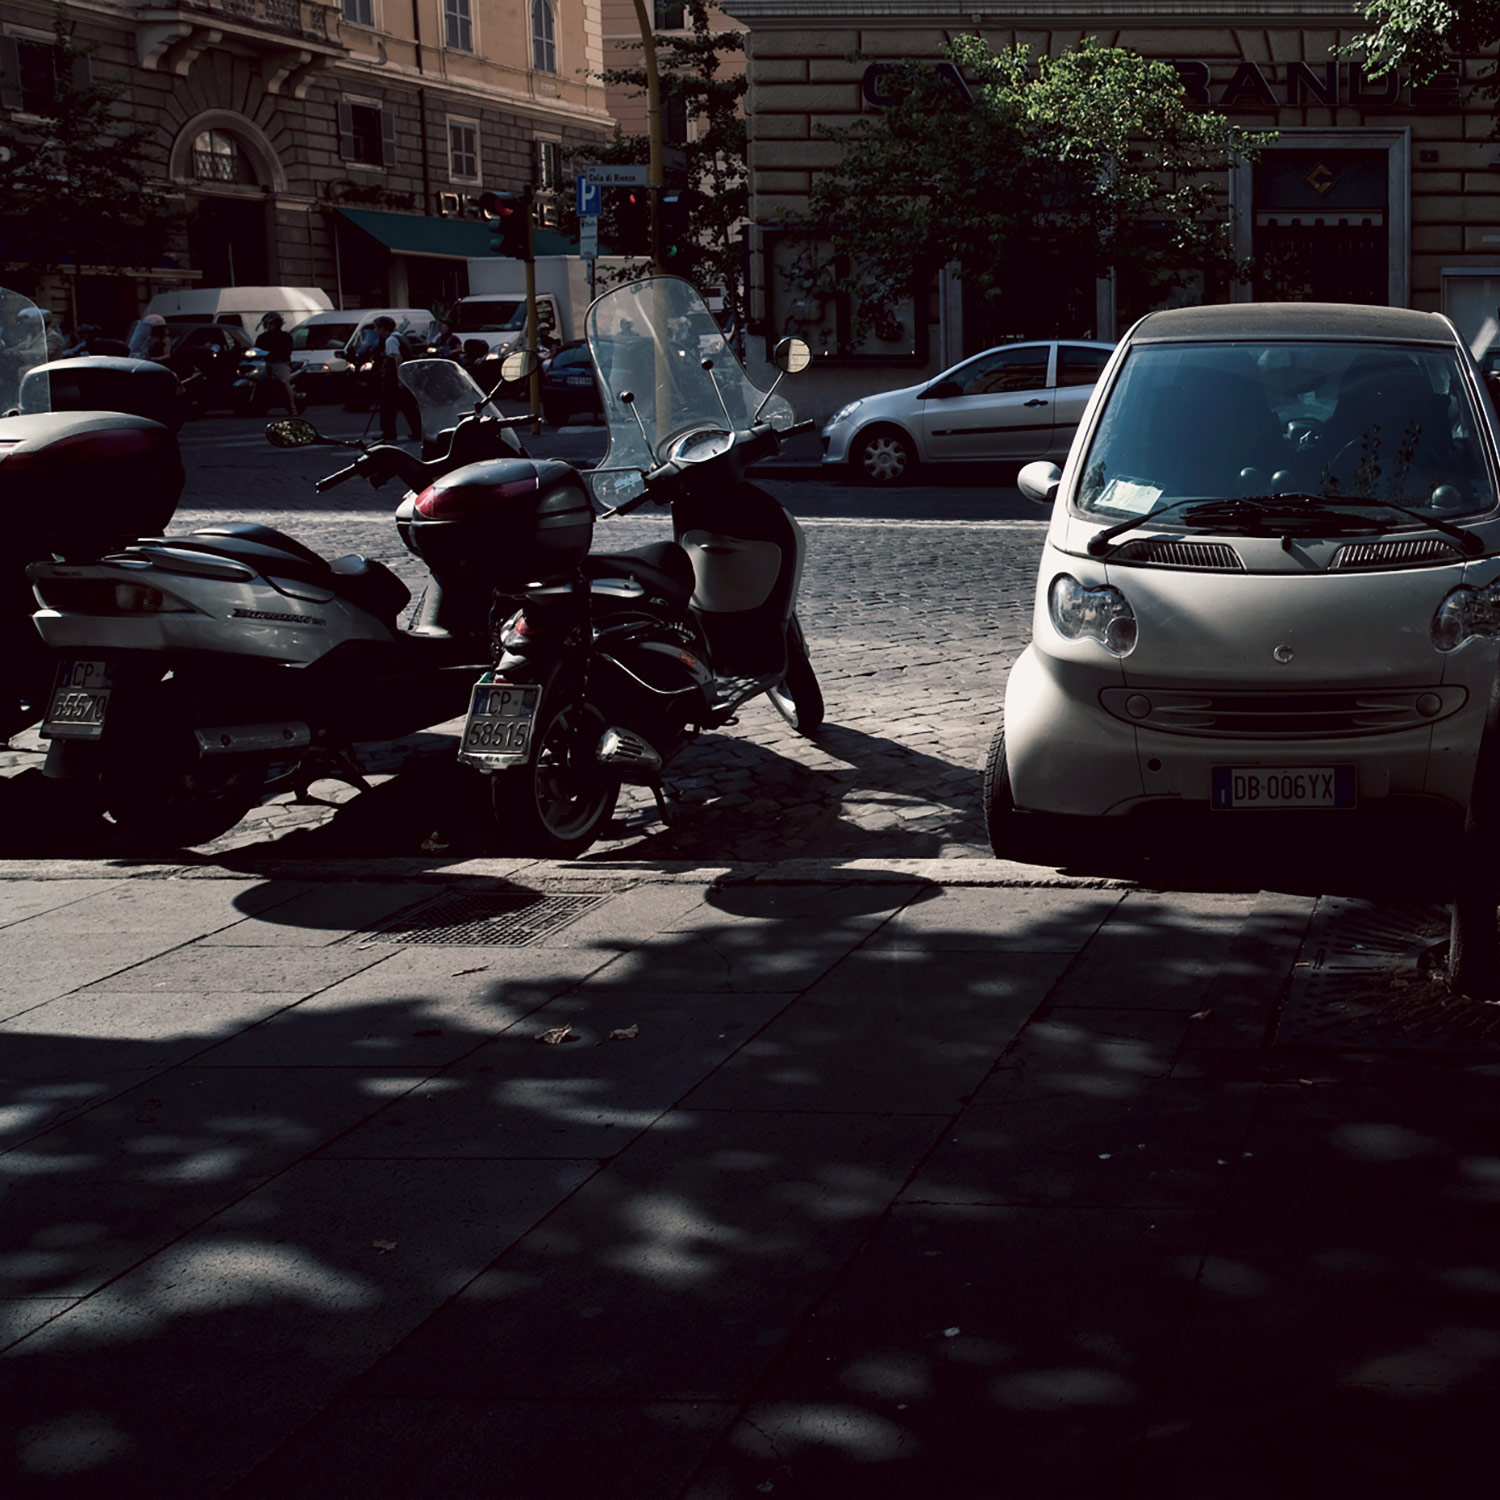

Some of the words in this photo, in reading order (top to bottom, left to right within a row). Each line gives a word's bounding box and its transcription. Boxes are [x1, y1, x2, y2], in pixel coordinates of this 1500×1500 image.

[589, 174, 604, 182] Cola
[606, 174, 612, 182] di
[614, 174, 636, 182] Rienzo
[73, 663, 94, 686] CP
[54, 693, 107, 719] 65570
[488, 691, 511, 715] CP
[469, 721, 528, 747] 58515
